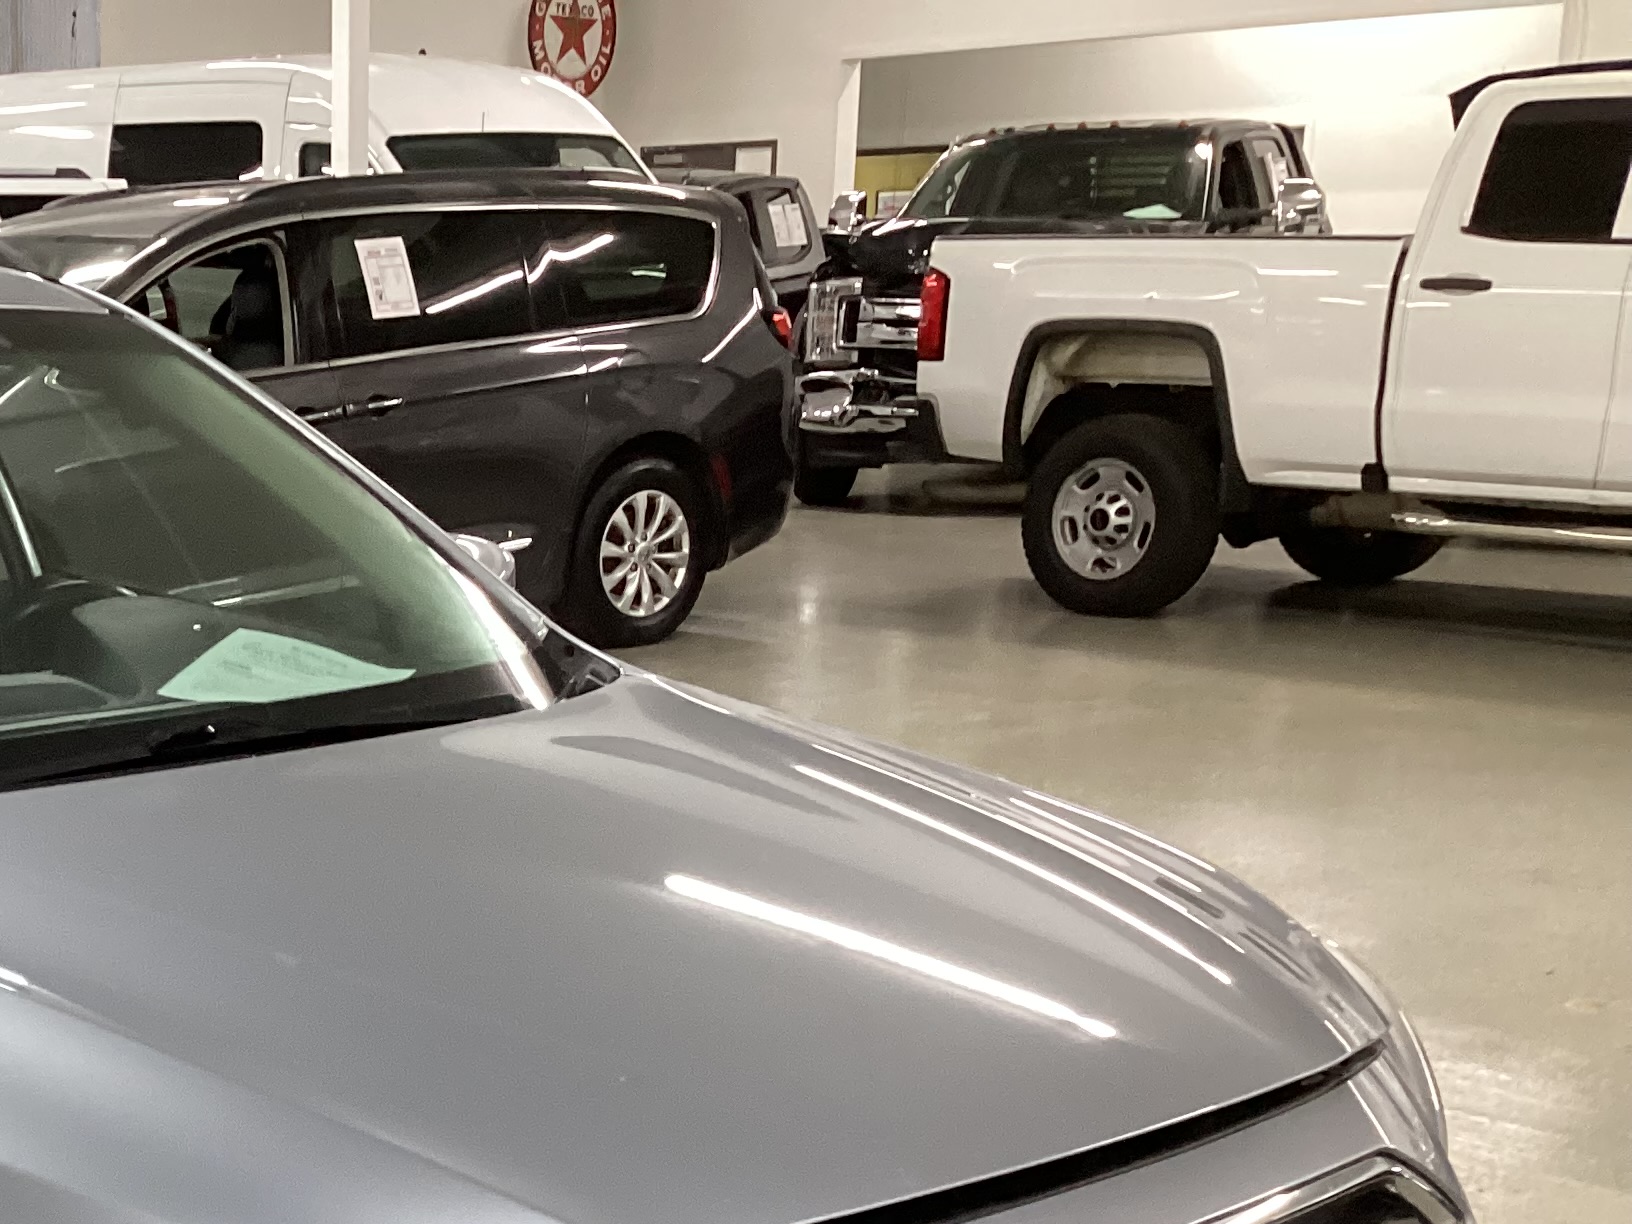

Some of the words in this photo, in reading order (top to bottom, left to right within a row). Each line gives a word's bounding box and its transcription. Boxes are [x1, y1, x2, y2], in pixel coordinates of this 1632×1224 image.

[554, 2, 595, 18] TEXCO
[532, 39, 586, 95] MOR
[590, 43, 612, 83] OIL
